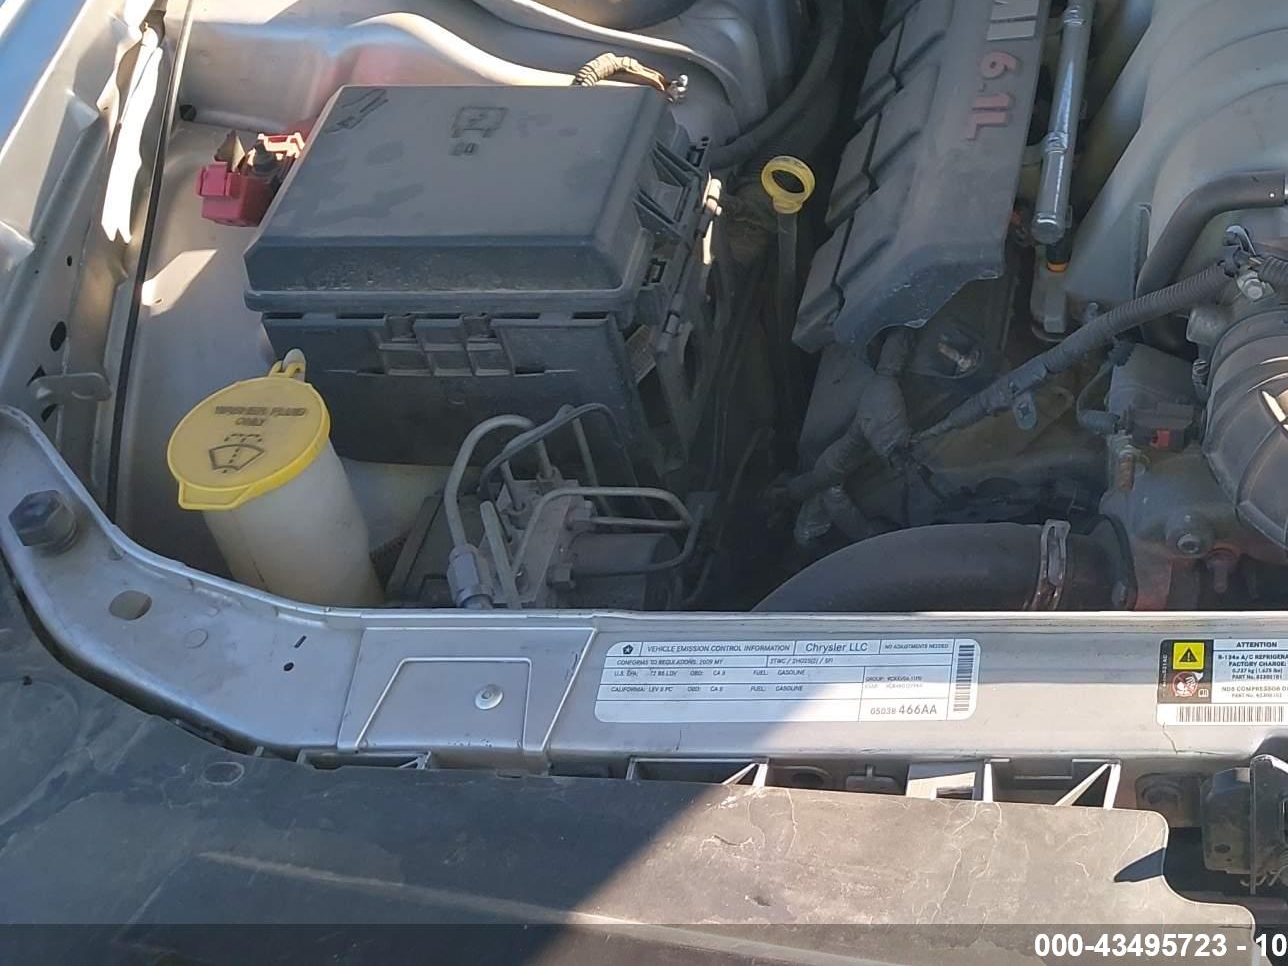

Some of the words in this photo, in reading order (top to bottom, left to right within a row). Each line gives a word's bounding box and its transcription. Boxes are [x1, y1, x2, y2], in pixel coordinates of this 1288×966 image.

[964, 50, 1017, 141] 6.1L
[270, 407, 306, 417] FLUID
[235, 418, 266, 426] ONLY
[743, 644, 790, 652] INFORMATION
[805, 642, 847, 653] Chrysler
[849, 642, 868, 652] LLC
